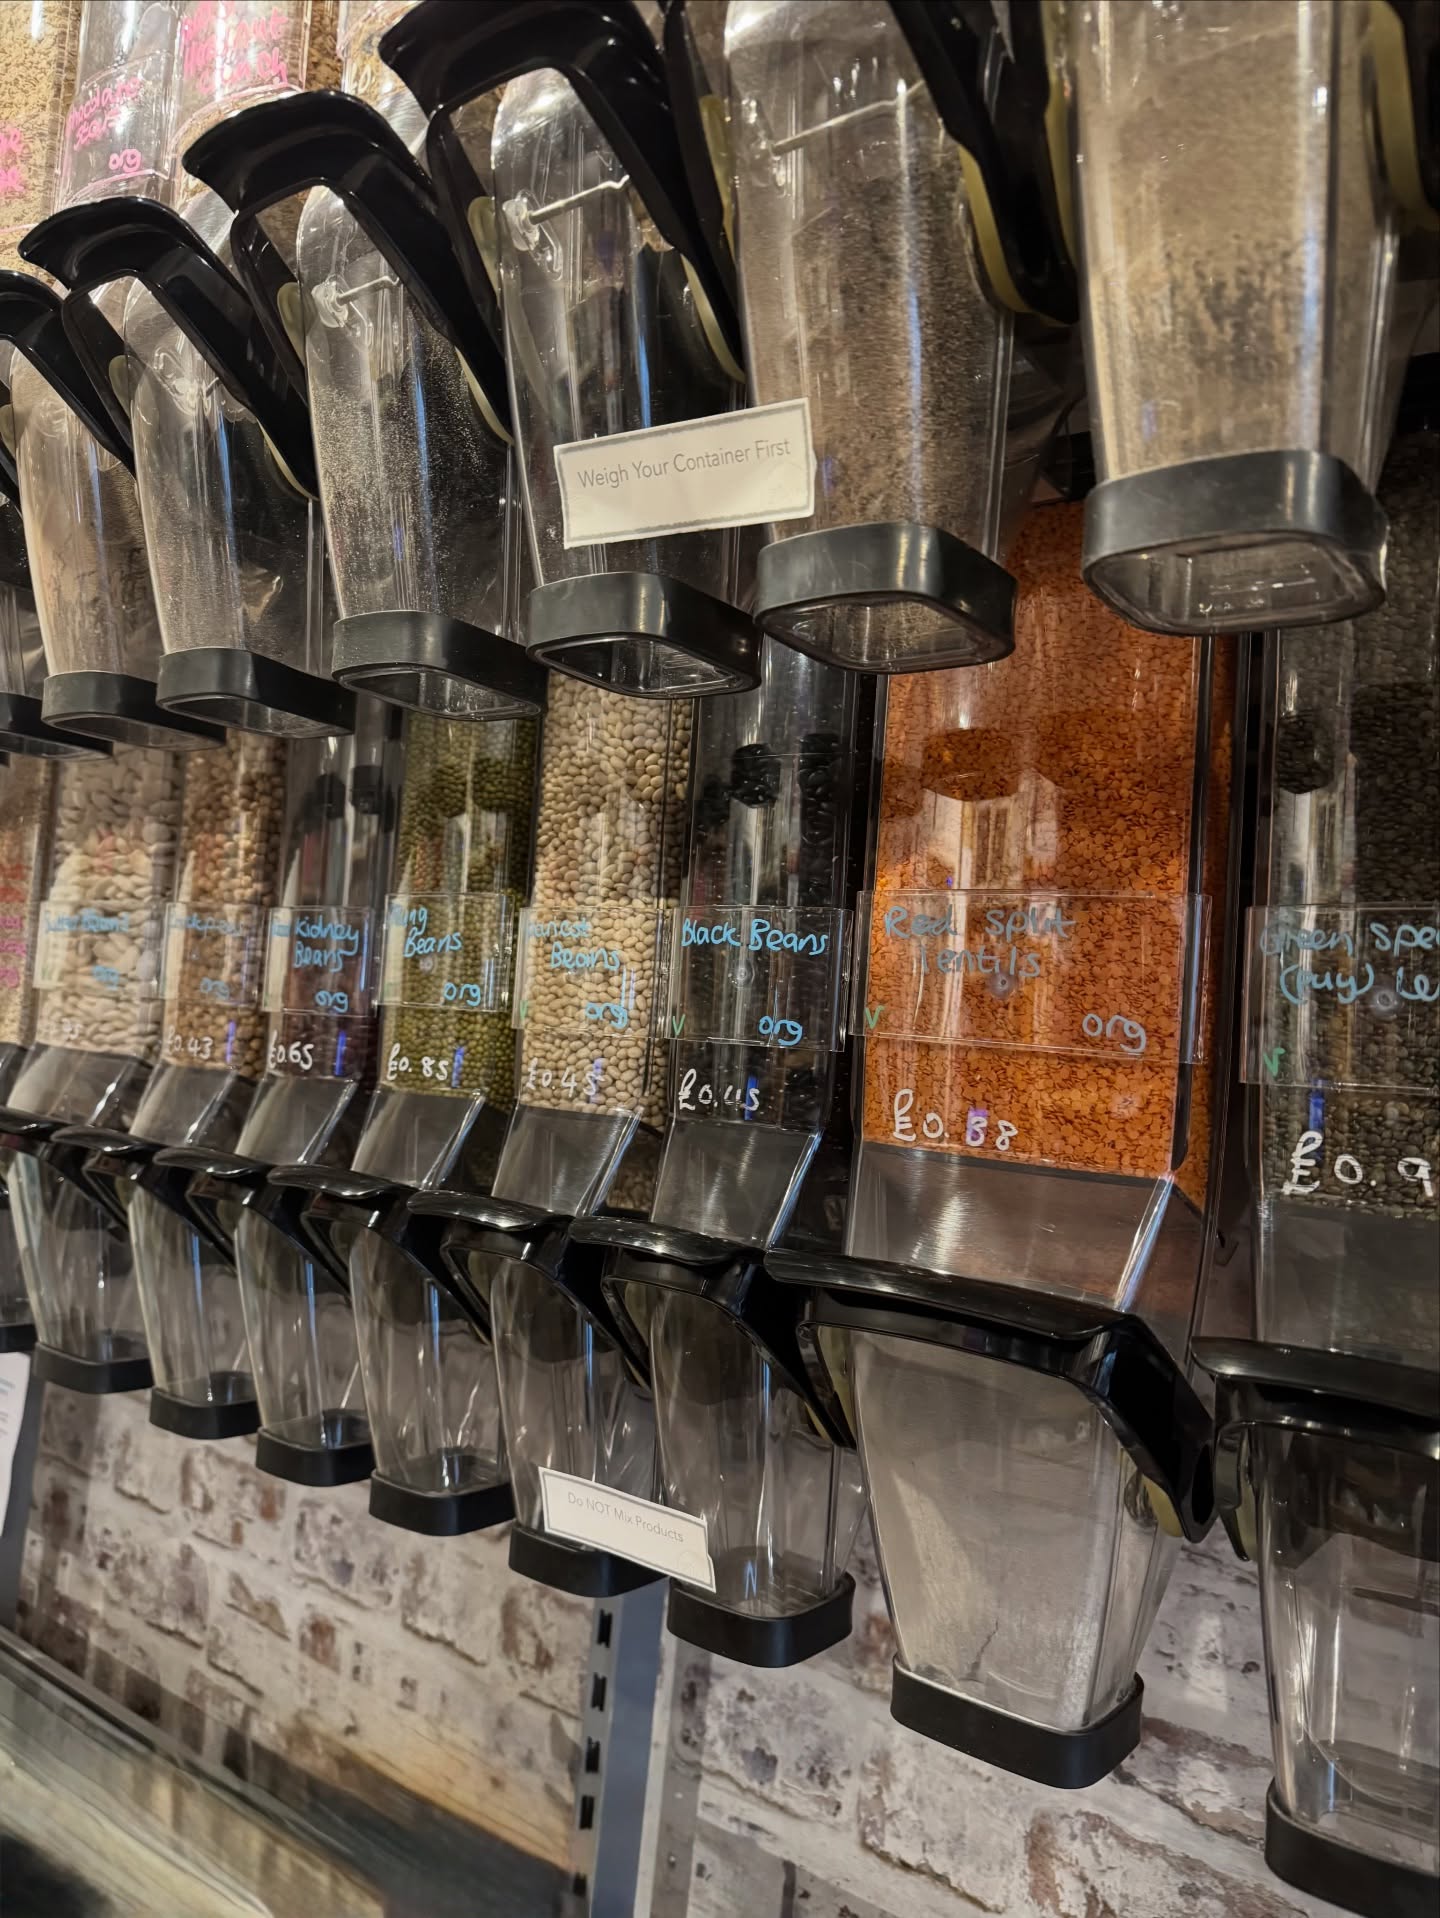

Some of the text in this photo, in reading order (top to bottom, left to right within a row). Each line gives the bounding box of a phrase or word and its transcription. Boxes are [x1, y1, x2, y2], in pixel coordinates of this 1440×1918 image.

[578, 438, 791, 489] Weigh Your Container First
[681, 917, 829, 956] Black Beans
[884, 903, 958, 938] Red
[293, 941, 343, 972] Beans
[404, 927, 462, 957] Beans
[551, 942, 620, 971] Beans
[315, 990, 348, 1013] org
[443, 982, 481, 1006] org
[585, 1002, 629, 1029] org
[758, 1016, 803, 1046] org
[267, 1029, 314, 1070] £0.65
[1082, 1013, 1147, 1055] org
[386, 1043, 449, 1081] £0.85
[526, 1057, 605, 1098] £0.45
[567, 1491, 684, 1543] Do NOT Mix Products
